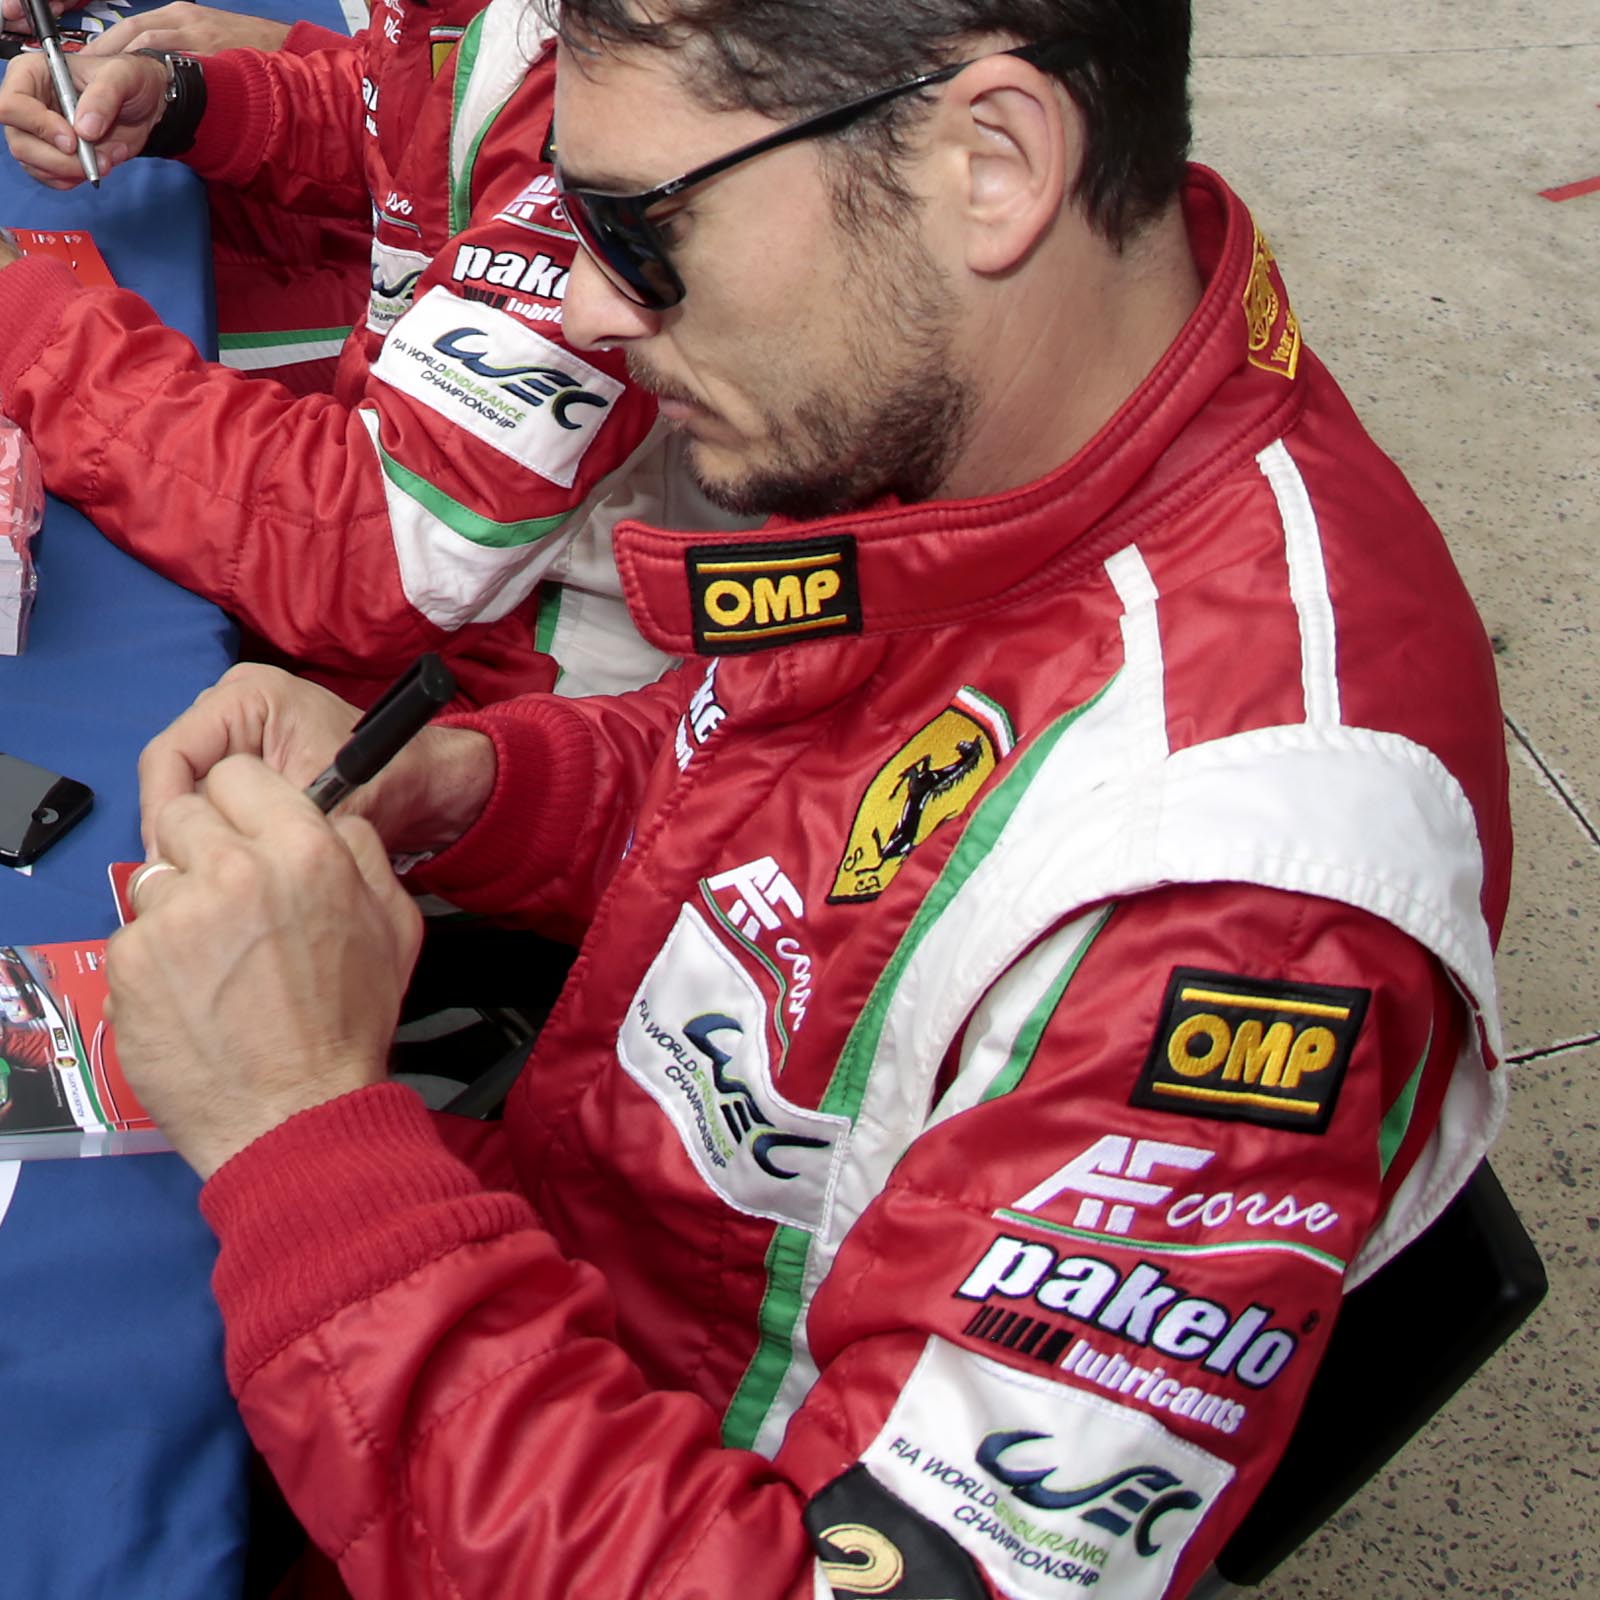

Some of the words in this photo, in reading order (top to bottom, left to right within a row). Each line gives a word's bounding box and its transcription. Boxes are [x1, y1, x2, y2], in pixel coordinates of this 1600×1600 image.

[406, 344, 446, 374] WORLD
[443, 367, 527, 423] ENDURANCE
[420, 369, 517, 431] CHAMPIONSHIP
[432, 326, 609, 430] WEC
[703, 568, 842, 627] OMP
[646, 1021, 698, 1073] WORLD
[1166, 1012, 1338, 1090] OMP
[665, 1065, 728, 1170] CHAMPIONSHIP
[682, 1011, 832, 1180] WEC
[1010, 1134, 1216, 1234] AF
[1165, 1191, 1340, 1233] corse
[953, 1233, 1299, 1390] pakelo
[1060, 1338, 1246, 1436] lubricants
[889, 1436, 921, 1472] FIA
[921, 1457, 998, 1511] WORLD
[975, 1430, 1204, 1558] WEC
[953, 1503, 1101, 1587] CHAMPIONSHIP
